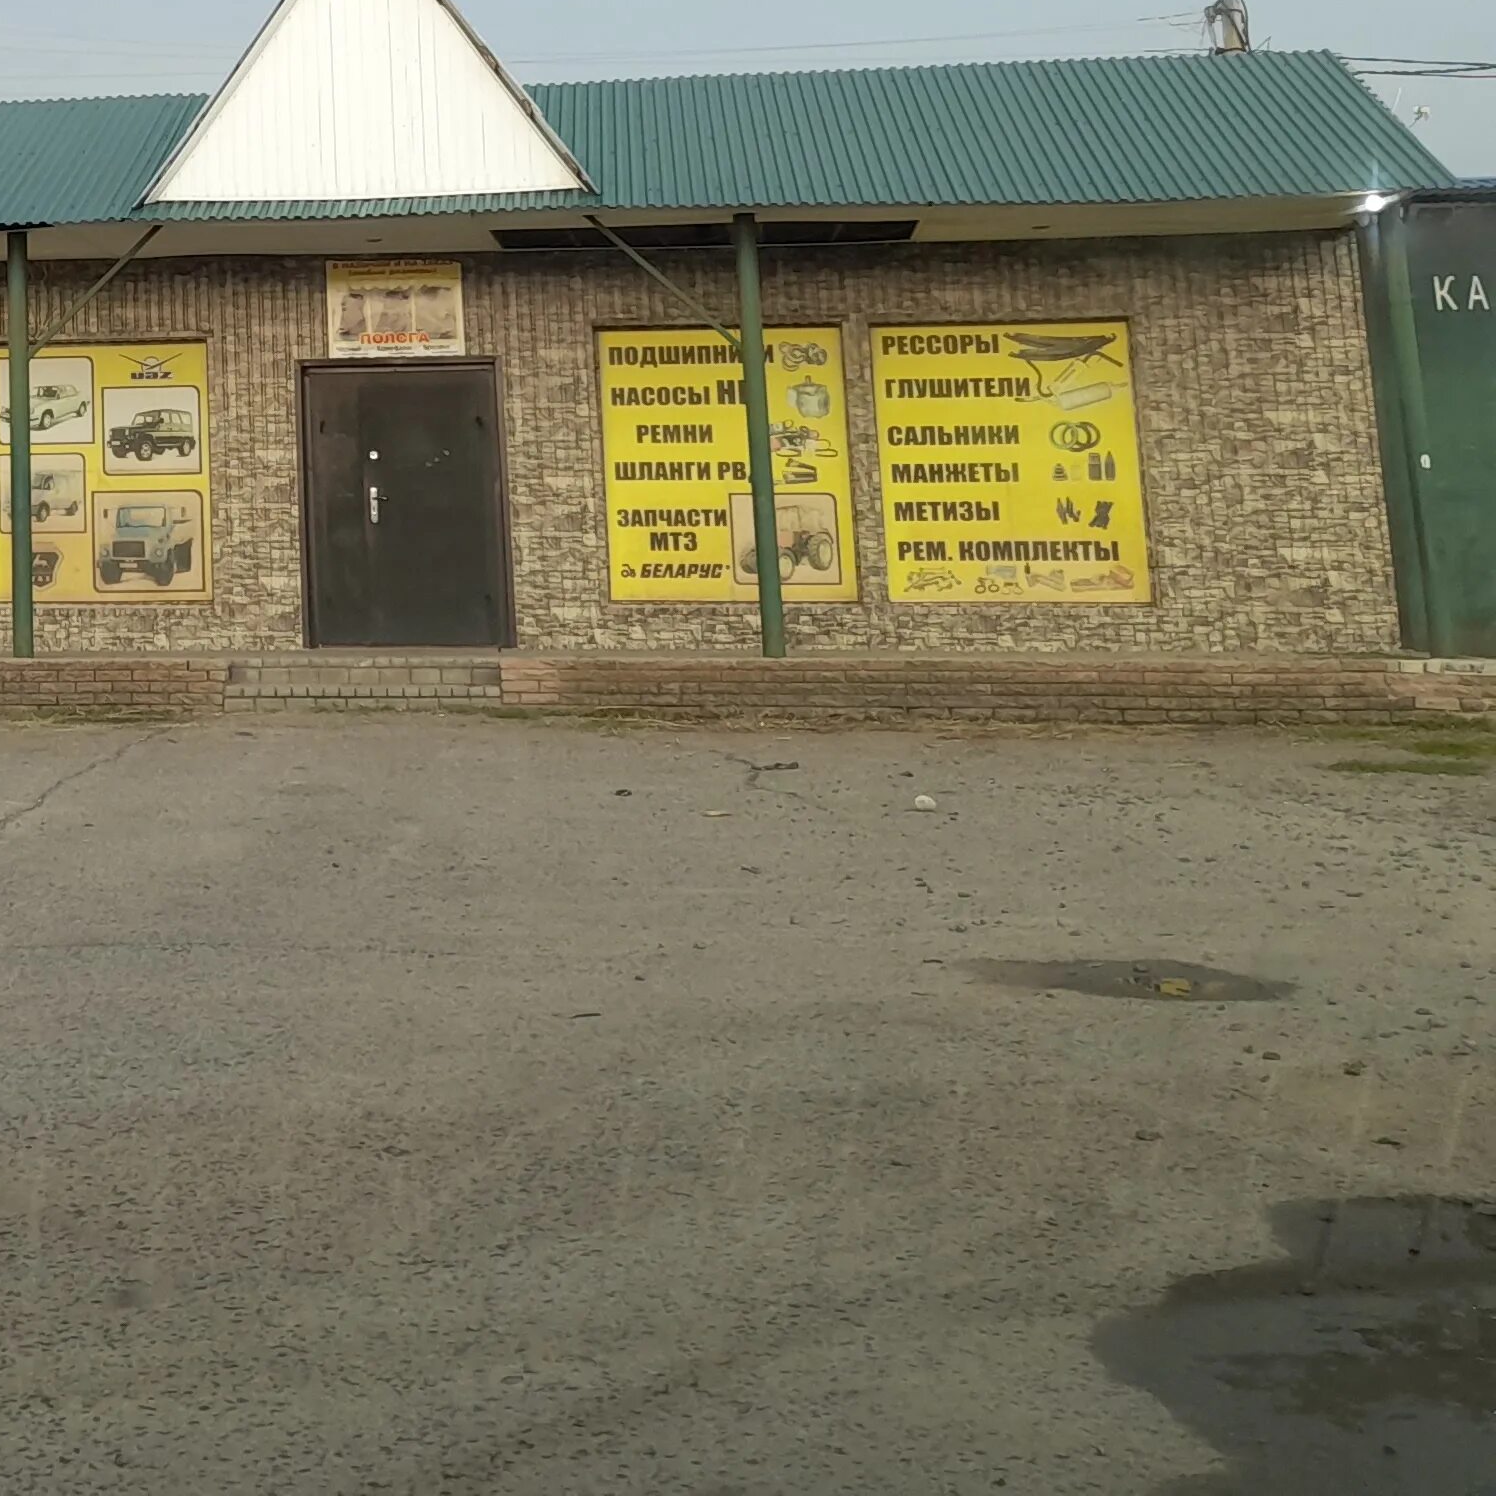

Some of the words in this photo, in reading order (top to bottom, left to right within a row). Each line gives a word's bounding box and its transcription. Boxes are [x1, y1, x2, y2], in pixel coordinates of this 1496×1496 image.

[881, 333, 999, 355] РЕССОРЫ
[608, 344, 774, 368] ПОДШИПНИИ
[611, 386, 711, 406] НАСОСЫ
[884, 377, 1030, 399] ГЛУШИТЕЛИ
[636, 424, 713, 443] РЕМНИ
[887, 424, 1019, 446] САЛЬНИКИ
[614, 461, 711, 481] ШЛАНГИ
[891, 462, 1019, 483] МАНЖЕТЫ
[616, 508, 727, 527] ЗАПЧАСТИ
[894, 501, 999, 522] МЕТИЗЫ
[650, 531, 698, 551] МТЗ
[897, 541, 953, 561] РЕМ.
[958, 540, 1120, 562] КОМПЛЕКТЫ
